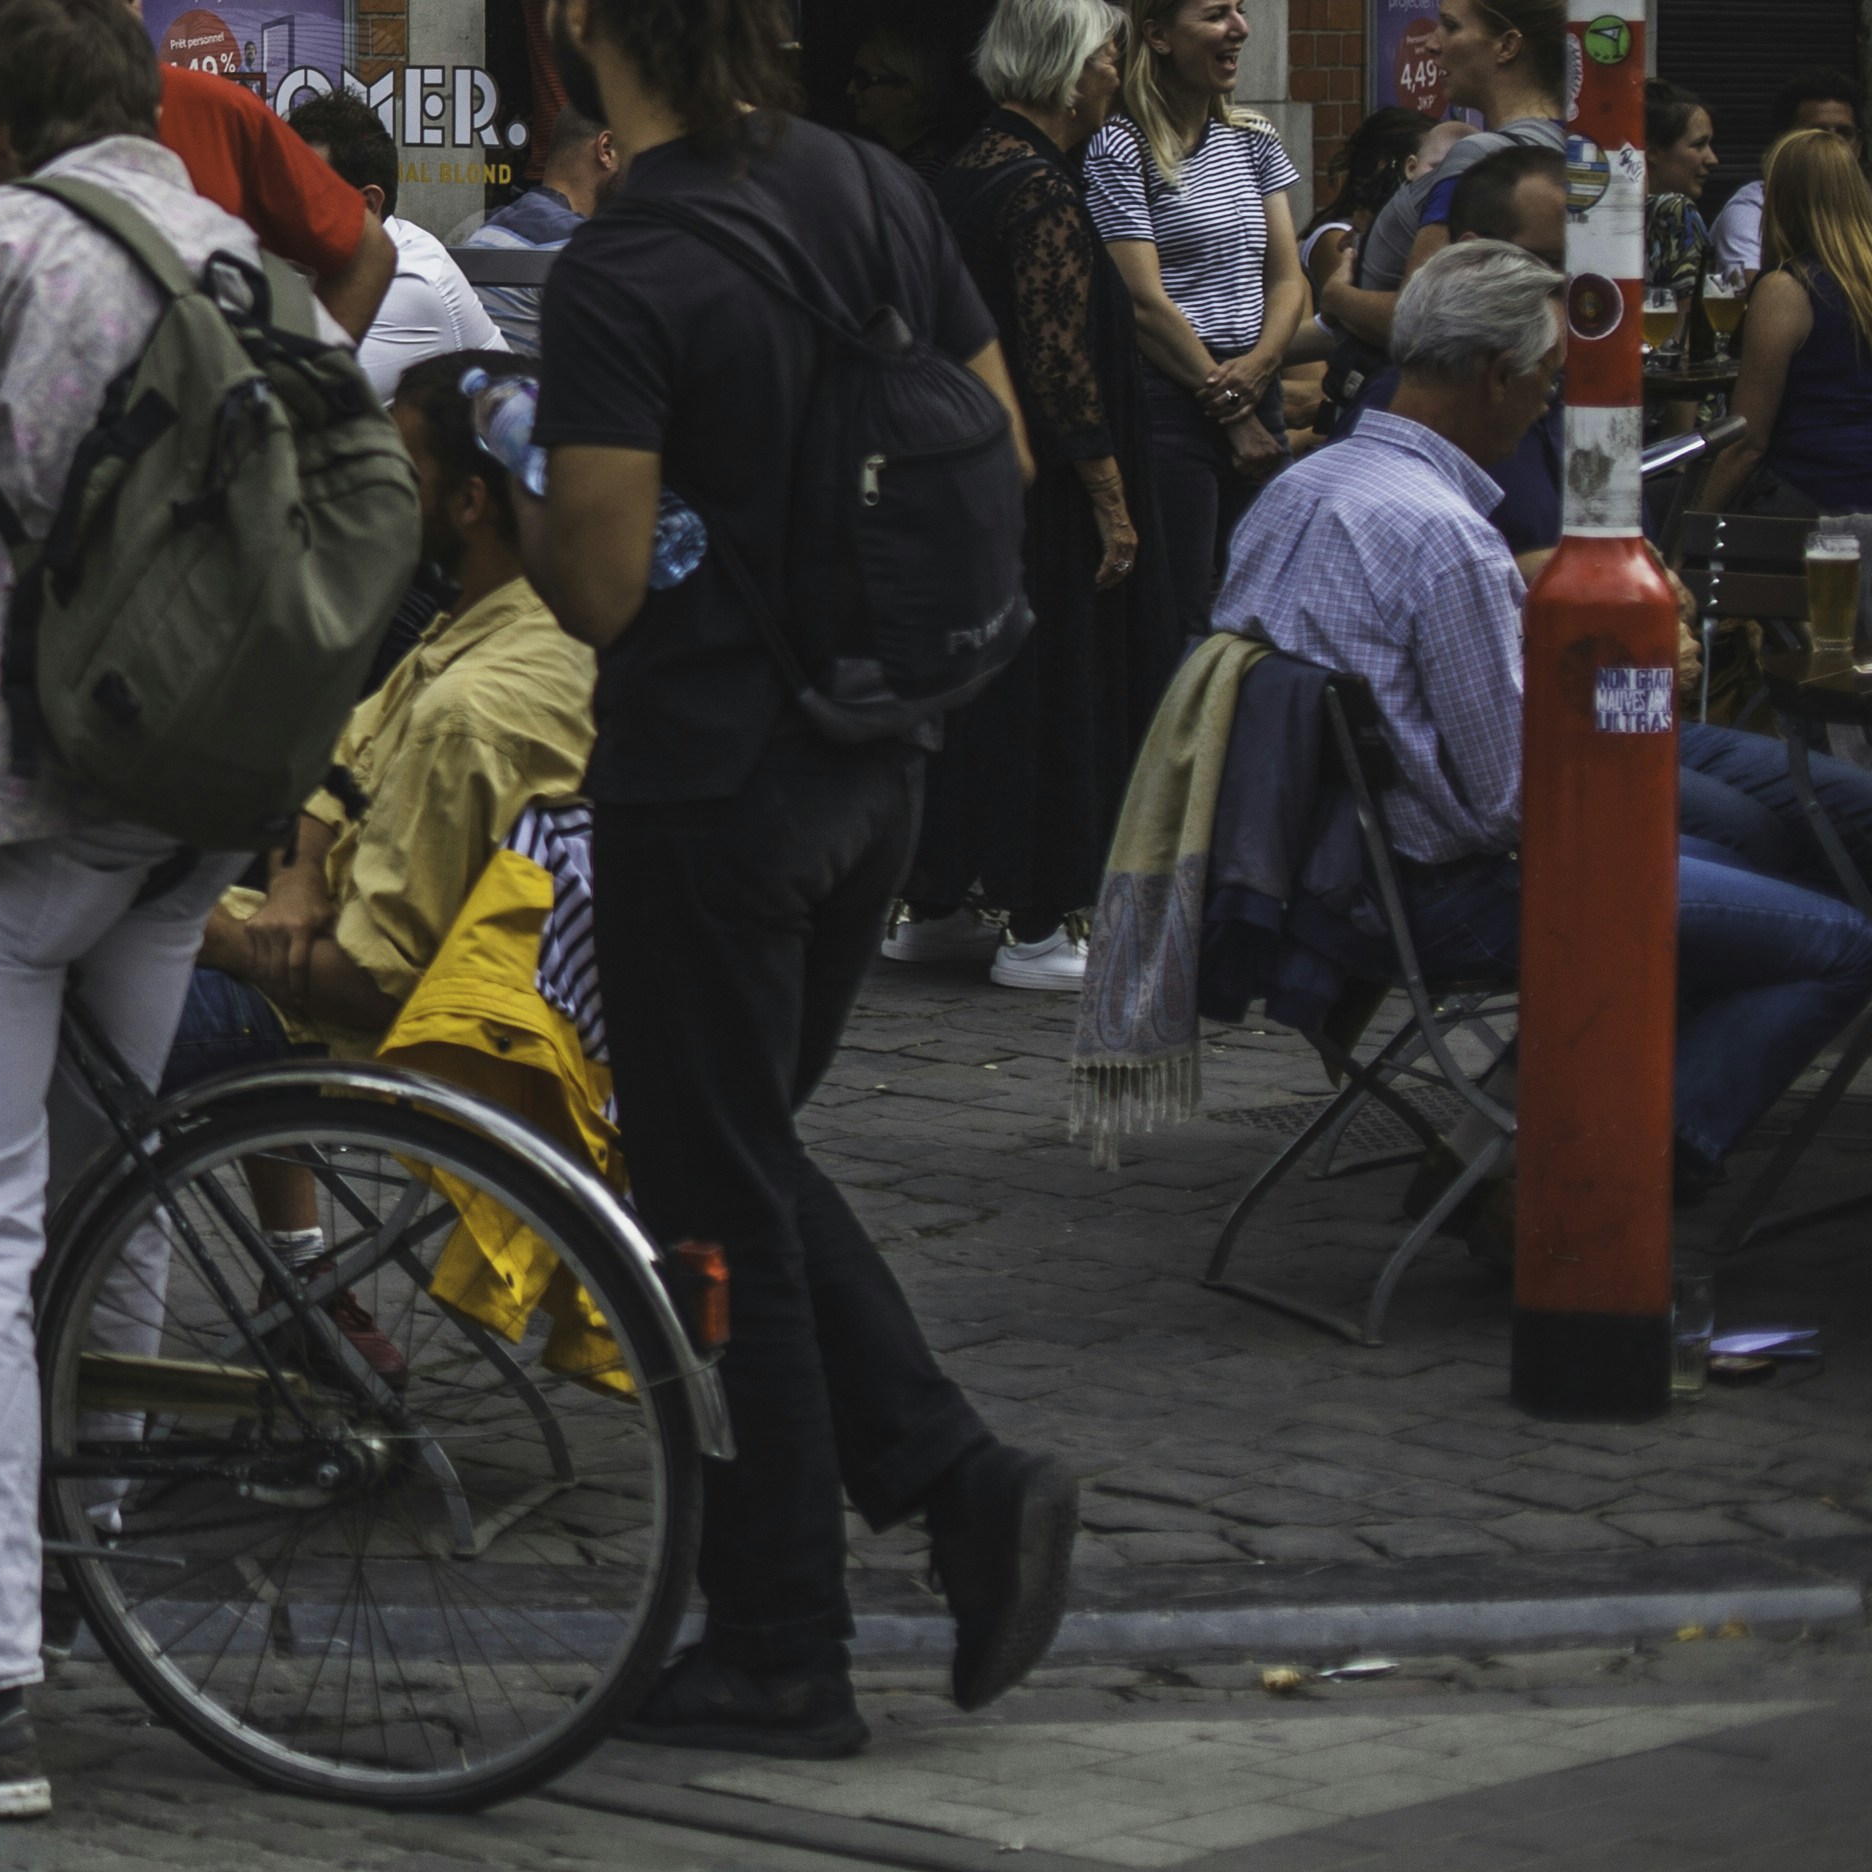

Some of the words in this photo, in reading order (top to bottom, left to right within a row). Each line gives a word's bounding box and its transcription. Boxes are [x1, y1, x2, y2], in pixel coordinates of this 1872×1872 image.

[170, 39, 187, 50] Prêt
[188, 32, 225, 49] personnel
[439, 163, 512, 185] BLOND
[1597, 669, 1628, 688] NON
[1596, 712, 1672, 732] ULTRAS
